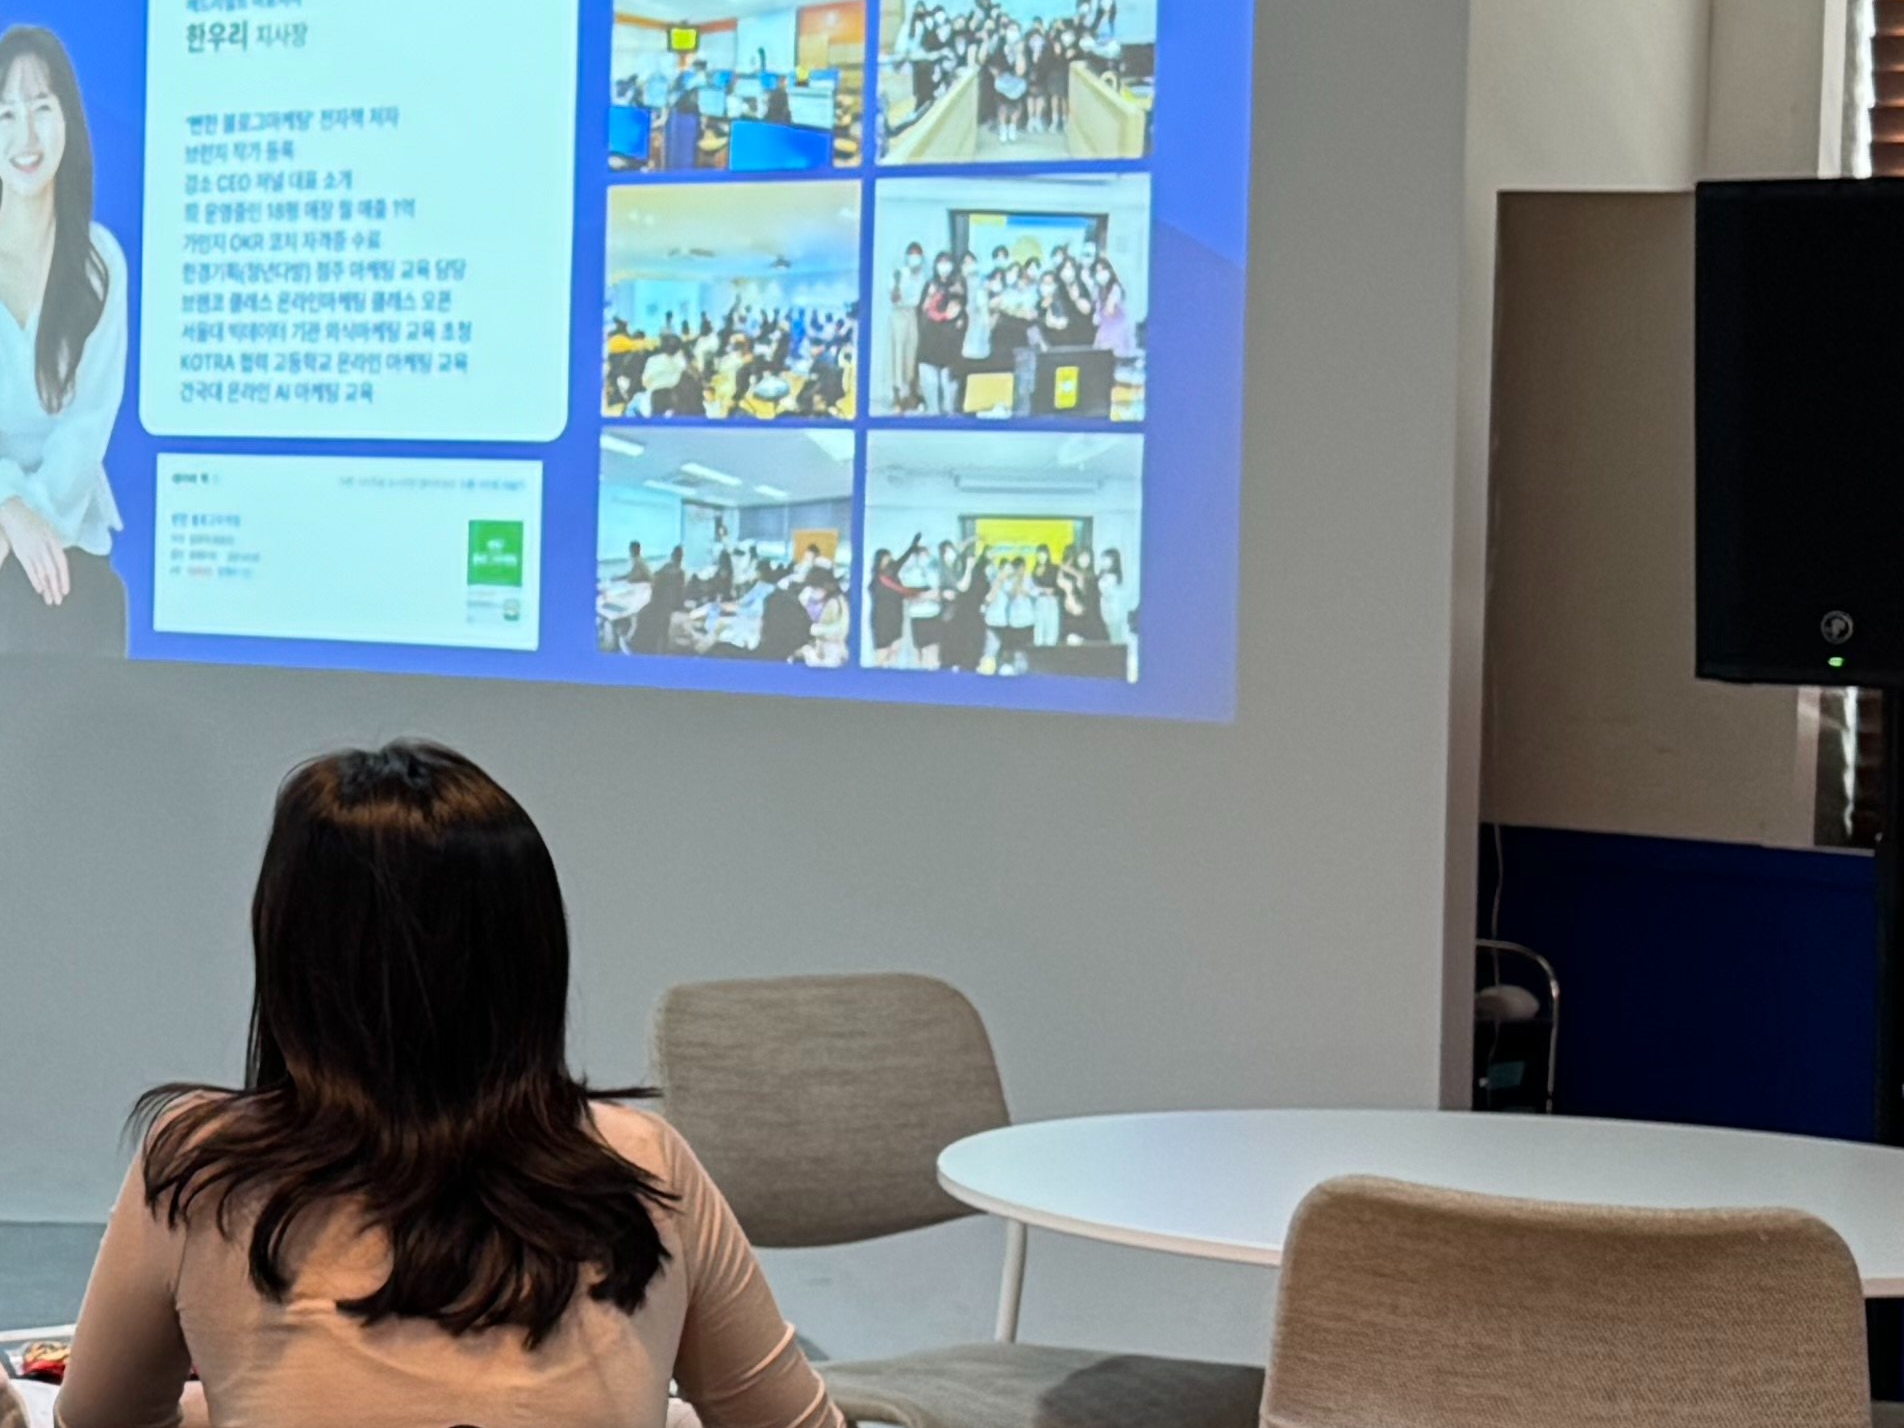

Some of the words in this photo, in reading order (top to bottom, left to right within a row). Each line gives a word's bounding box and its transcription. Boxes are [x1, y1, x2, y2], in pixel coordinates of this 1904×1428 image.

[186, 19, 249, 54] 한우리
[216, 172, 251, 193] CEO
[180, 353, 234, 372] KOTRA
